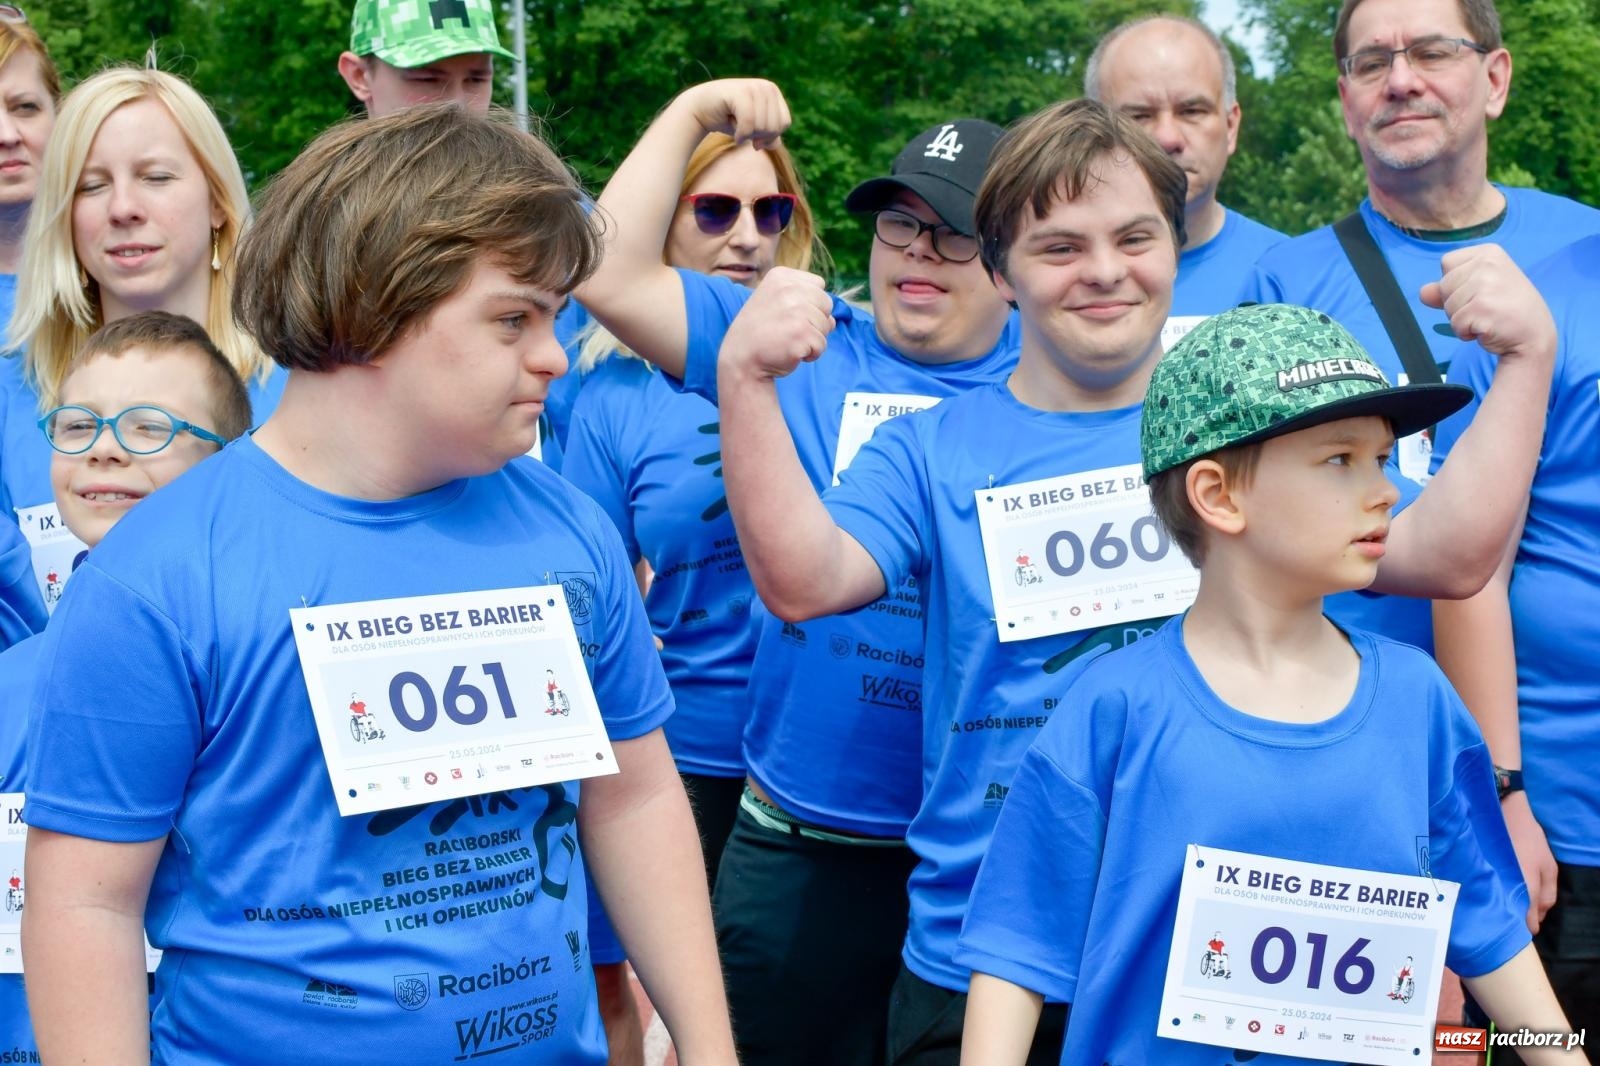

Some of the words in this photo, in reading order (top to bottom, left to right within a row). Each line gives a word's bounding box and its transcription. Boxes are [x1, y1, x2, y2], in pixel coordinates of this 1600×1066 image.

[924, 124, 963, 161] LA
[866, 404, 882, 416] IX
[1003, 496, 1025, 512] IX
[1029, 488, 1074, 508] BIEG
[1080, 480, 1118, 498] BEZ
[40, 515, 55, 530] IX
[1045, 515, 1170, 577] 060
[326, 622, 353, 642] IX
[359, 615, 413, 638] BIEG
[420, 610, 462, 632] BEZ
[468, 604, 544, 629] BARIER
[856, 642, 925, 669] Racibó
[388, 662, 518, 732] 061
[862, 674, 920, 704] Wiko
[448, 744, 502, 760] 25.05.2024
[8, 808, 24, 824] IX
[424, 828, 522, 857] RACIBORSKI
[382, 866, 429, 888] BIEG
[434, 859, 470, 878] BEZ
[474, 846, 532, 871] BARIER
[244, 907, 275, 922] DLA
[278, 901, 324, 921] OSÓB
[328, 867, 535, 919] NIEPEŁNOSPRAWNYCH
[1214, 886, 1232, 896] DLA
[1216, 864, 1241, 884] IX
[1247, 871, 1302, 894] BIEG
[1309, 878, 1350, 901] BEZ
[1357, 885, 1430, 910] BARIER
[396, 915, 428, 932] ICH
[432, 889, 536, 926] OPIEKUNÓW
[1250, 926, 1375, 994] 016
[438, 955, 552, 998] Racibórz
[1281, 1006, 1332, 1022] 25.05.2024
[521, 1025, 556, 1046] SPORT
